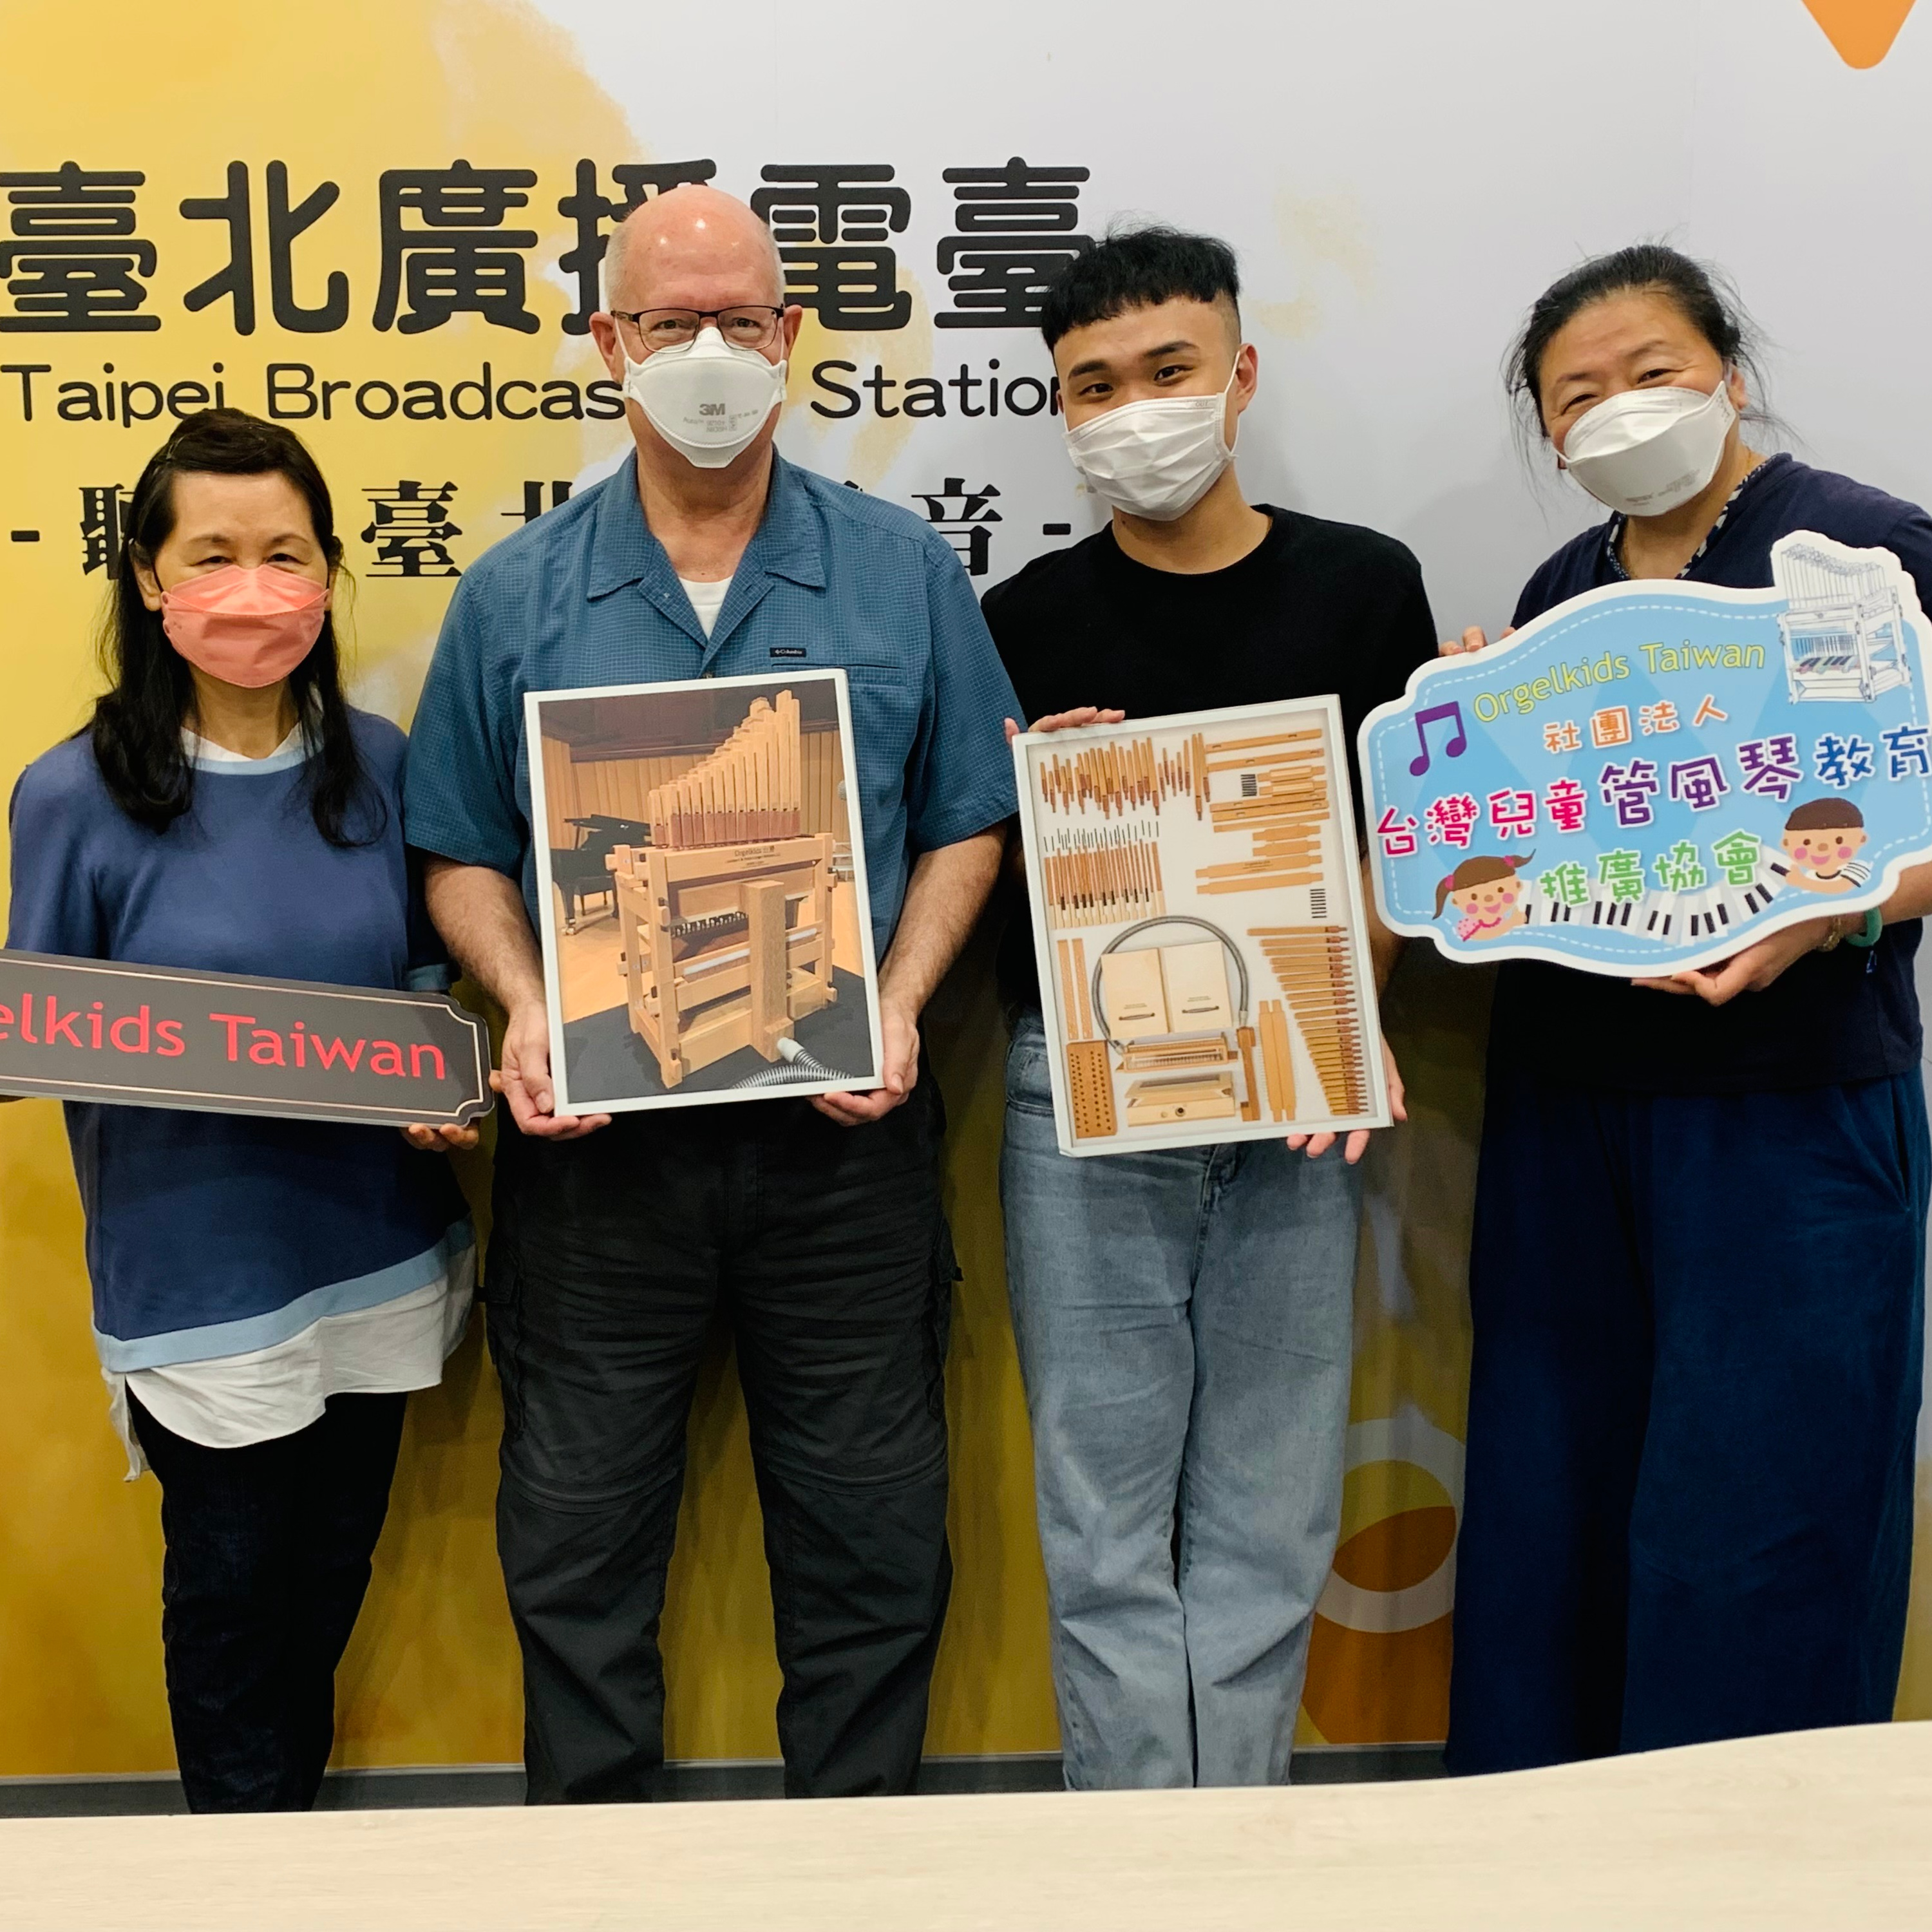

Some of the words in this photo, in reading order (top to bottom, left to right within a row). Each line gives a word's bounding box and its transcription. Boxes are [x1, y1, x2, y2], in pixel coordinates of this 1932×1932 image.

[1, 361, 225, 428] Taipei
[266, 361, 626, 421] Broadcas
[810, 359, 1061, 417] Statio
[699, 403, 726, 416] 3M
[1473, 651, 1631, 723] Orgelkids
[1639, 639, 1765, 674] Taiwan
[1544, 696, 1727, 752] 社團法人
[1377, 725, 1929, 855] 台灣兒童管風琴教育
[1539, 831, 1761, 905] 推廣協會
[209, 1012, 446, 1080] Taiwan
